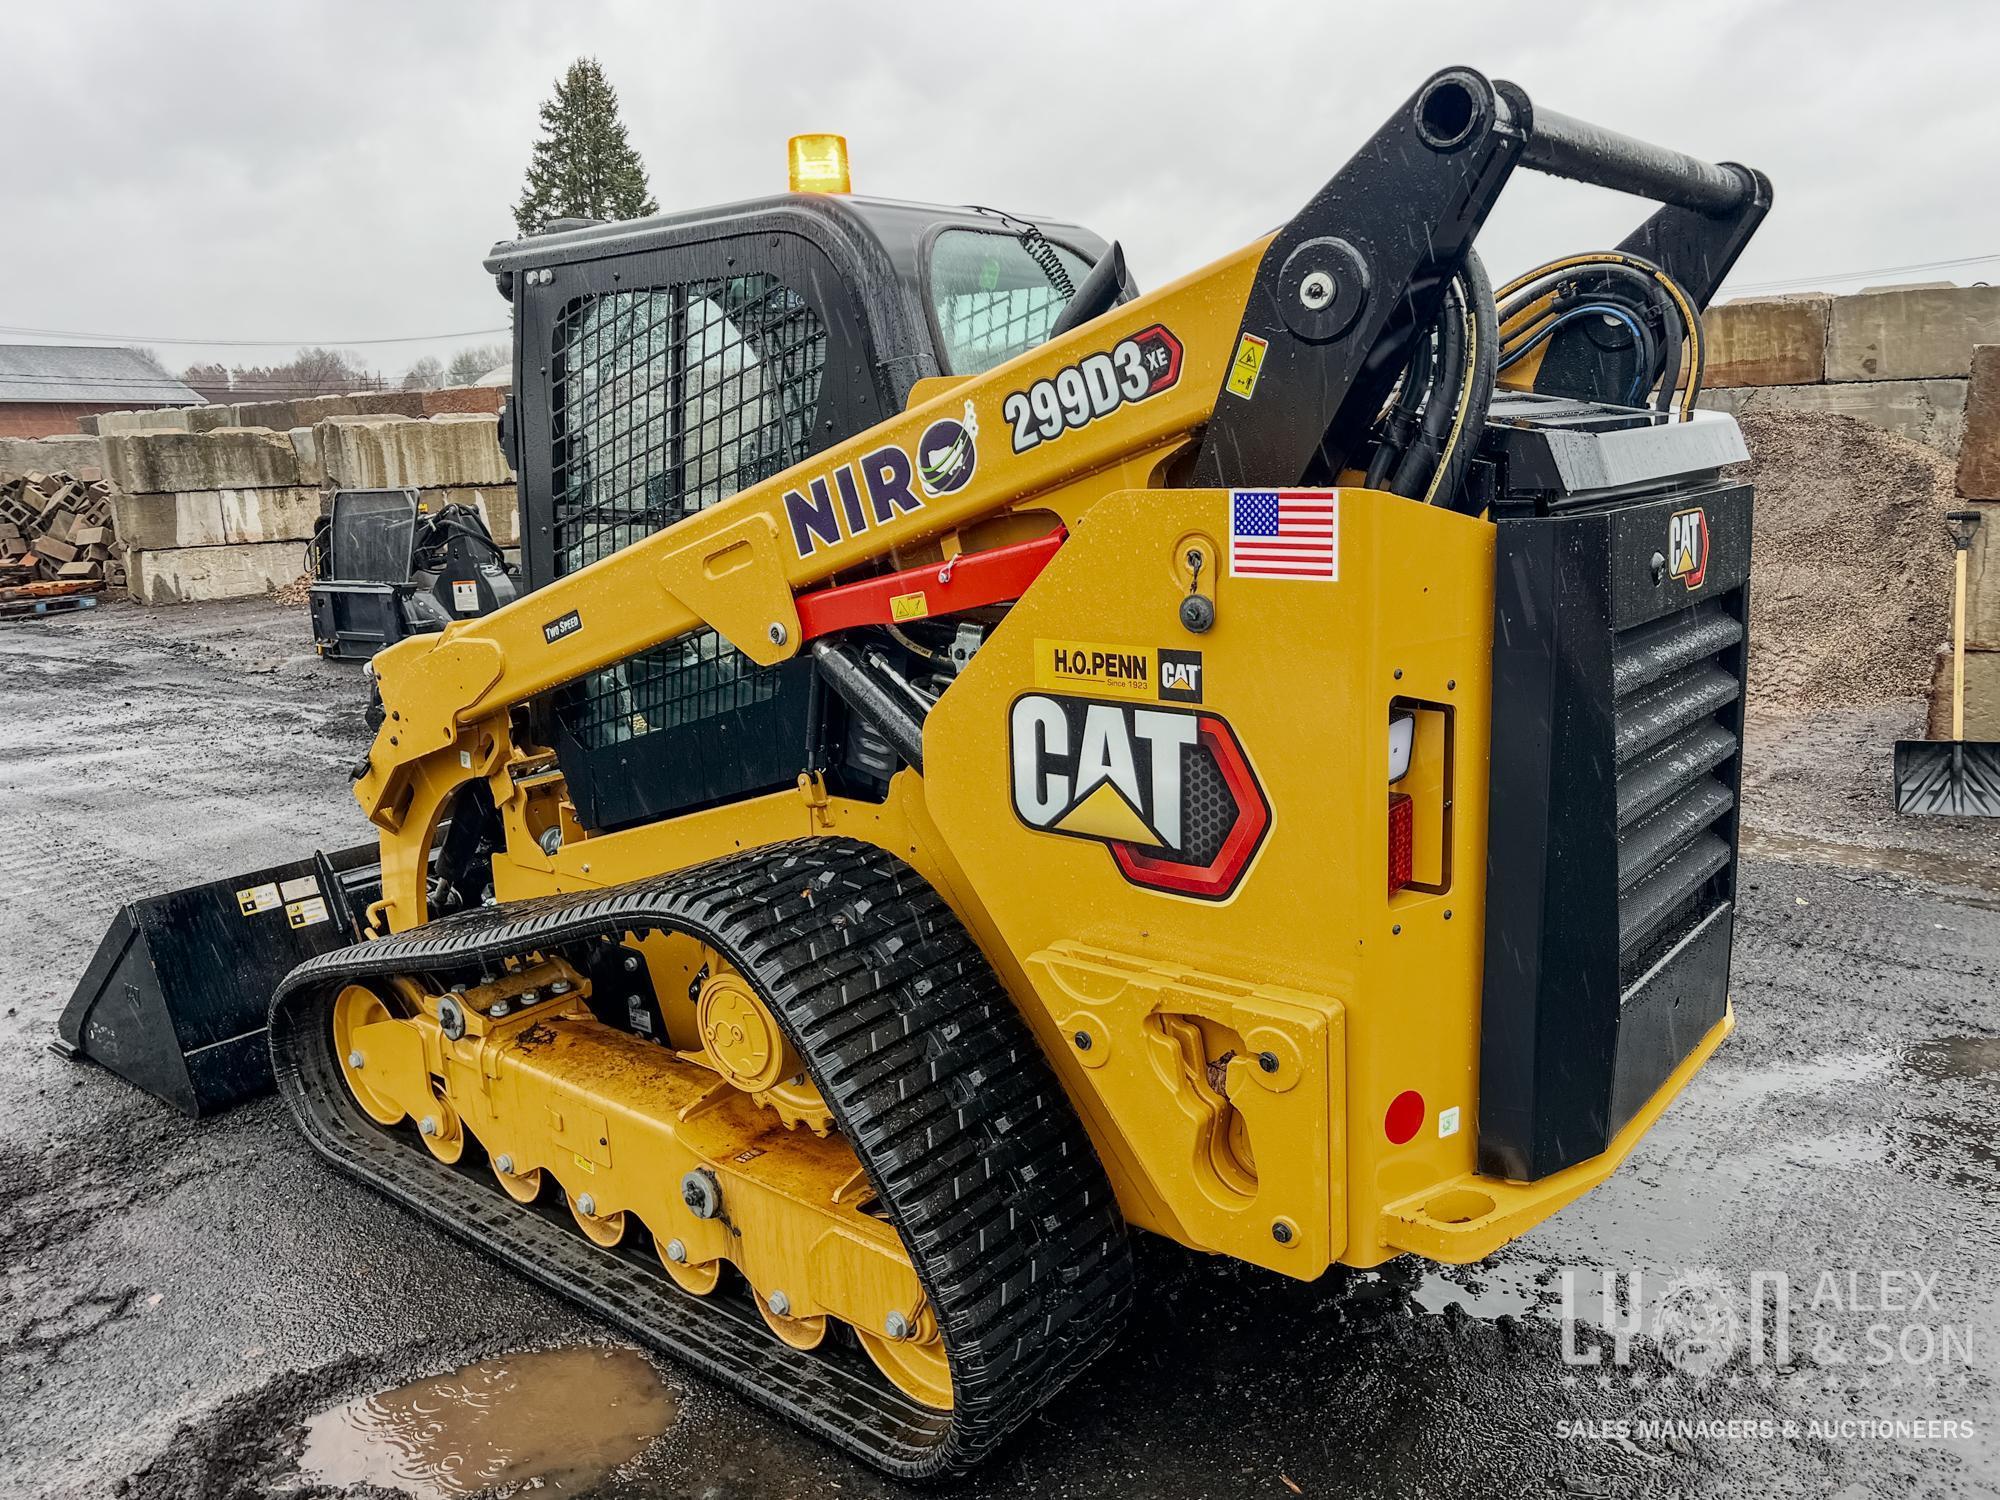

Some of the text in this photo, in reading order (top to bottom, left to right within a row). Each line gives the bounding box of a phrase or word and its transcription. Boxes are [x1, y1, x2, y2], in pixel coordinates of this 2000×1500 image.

[1004, 340, 1169, 451] 299D3 XE
[782, 416, 977, 559] NIRO
[1670, 511, 1700, 575] CAT
[1054, 648, 1147, 681] H.O.PENN
[1106, 678, 1148, 690] Since 1923
[1161, 661, 1201, 691] CAT
[1012, 695, 1198, 850] CAT
